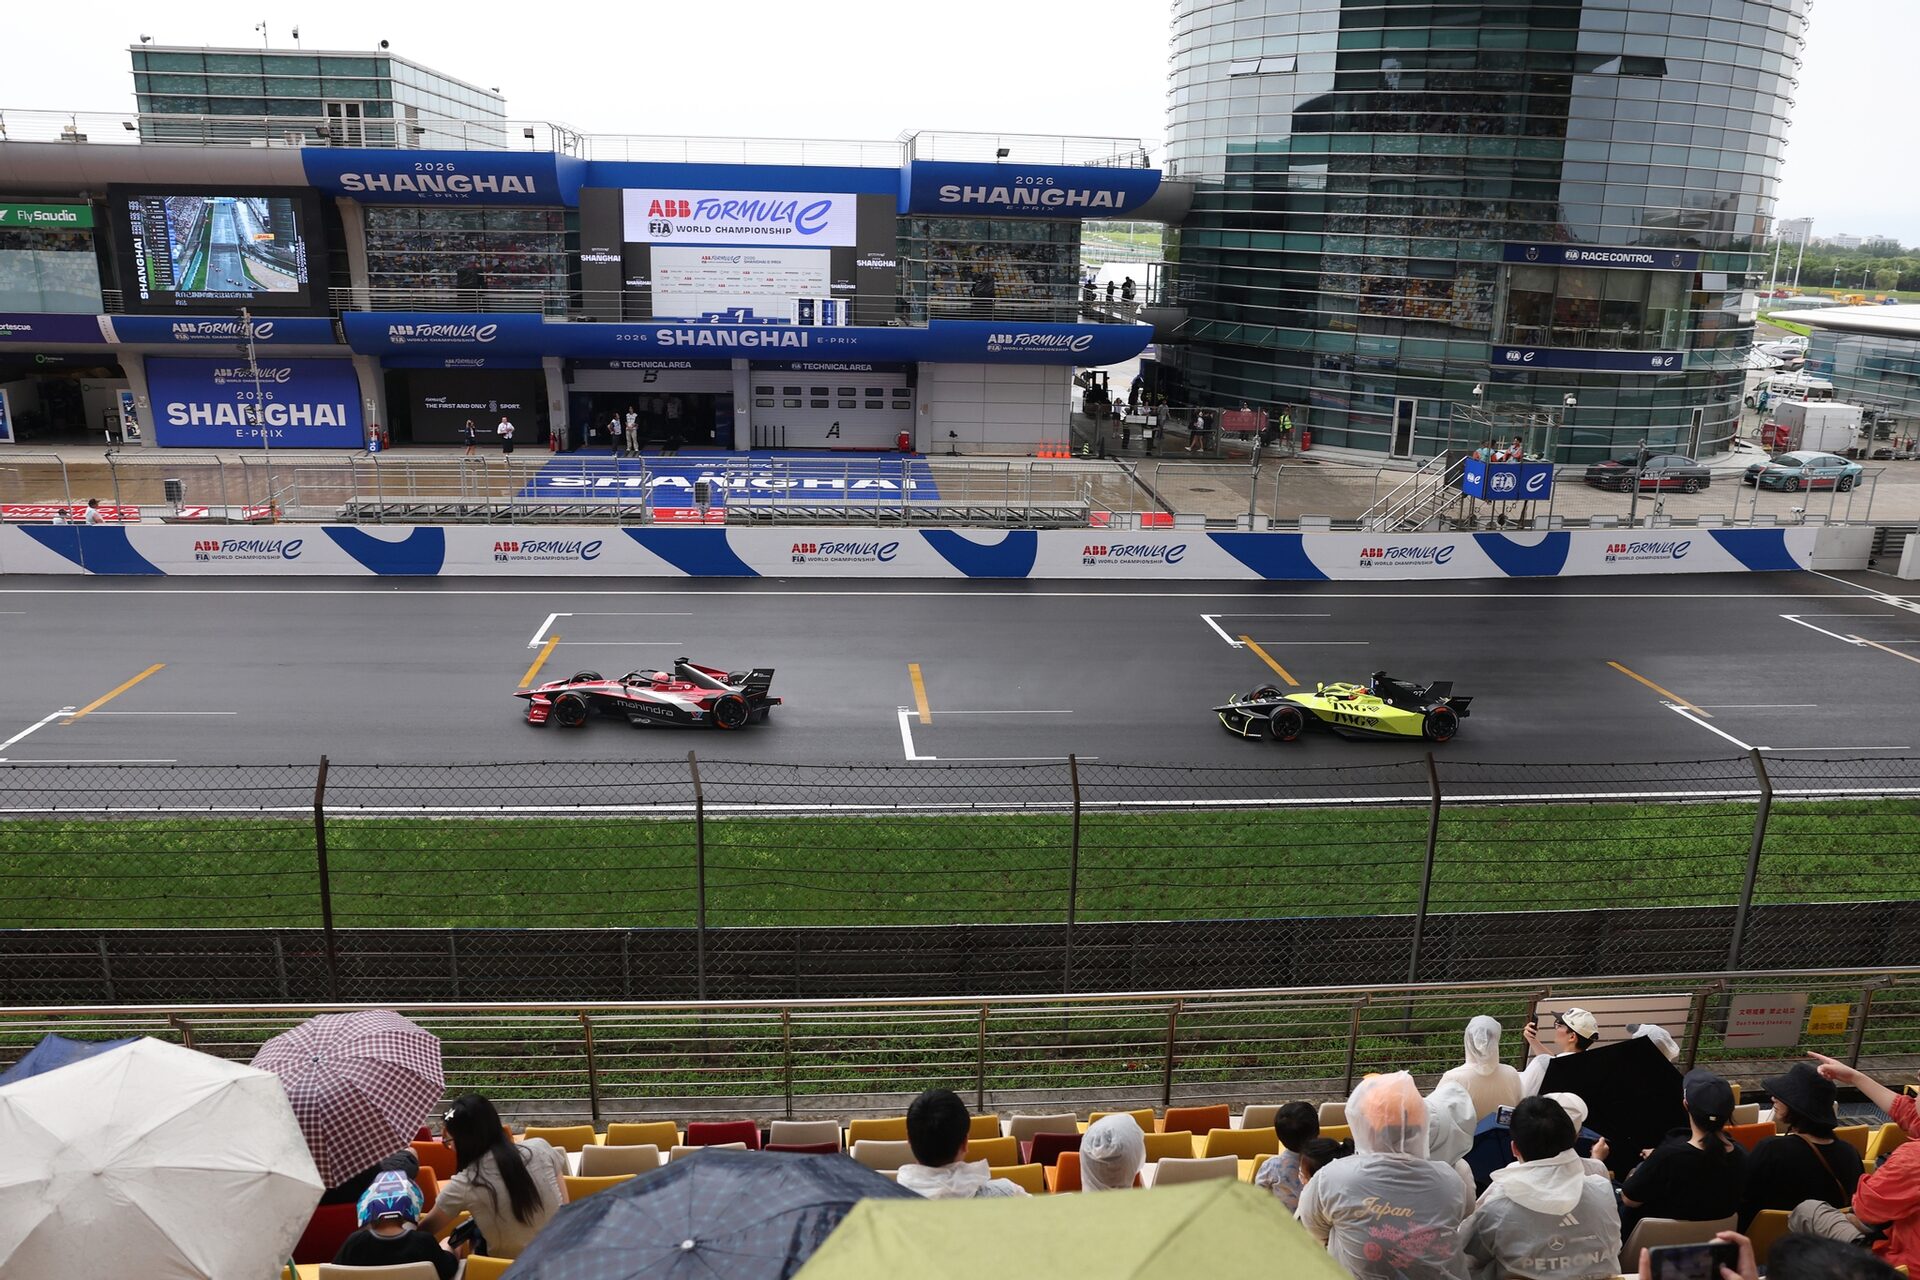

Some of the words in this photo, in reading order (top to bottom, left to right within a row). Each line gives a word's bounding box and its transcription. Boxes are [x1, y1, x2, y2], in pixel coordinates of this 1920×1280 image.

[414, 162, 455, 171] 2026
[340, 173, 536, 193] SHANGHAI
[1016, 176, 1054, 185] 2026
[939, 185, 1126, 208] SHANGHAI
[17, 209, 77, 223] FlySaudia
[648, 200, 691, 218] ABB
[693, 198, 798, 223] FORMULA
[716, 226, 792, 234] CHAMPIONSHIP
[1581, 252, 1609, 261] RACE
[1610, 253, 1654, 263] CONTROL
[134, 238, 149, 300] SHANGHAI
[710, 315, 719, 324] 2
[734, 310, 745, 323] 1
[172, 322, 196, 332] ABB
[389, 325, 414, 335] ABB
[416, 324, 477, 337] FORMULA
[656, 329, 808, 348] SHANGHAI
[988, 334, 1013, 344] ABB
[1013, 334, 1074, 346] FORMULA
[236, 392, 274, 400] 2026
[167, 403, 346, 426] SHANGHAI
[236, 429, 283, 438] E-PRIX
[825, 421, 840, 439] A
[548, 476, 917, 490] SHANGHAI
[194, 540, 220, 551] ABB
[221, 540, 282, 552] FORMULA
[494, 542, 519, 552] ABB
[520, 540, 582, 553] FORMULA
[792, 543, 816, 553] ABB
[818, 542, 879, 555] FORMULA
[1082, 546, 1107, 555] ABB
[1108, 544, 1168, 557] FORMULA
[1360, 548, 1383, 558] ABB
[1384, 546, 1438, 559] FORMULA
[1606, 544, 1626, 553] ABB
[1627, 542, 1676, 553] FORMULA
[617, 700, 674, 716] mahindra
[1354, 1197, 1415, 1221] Japan
